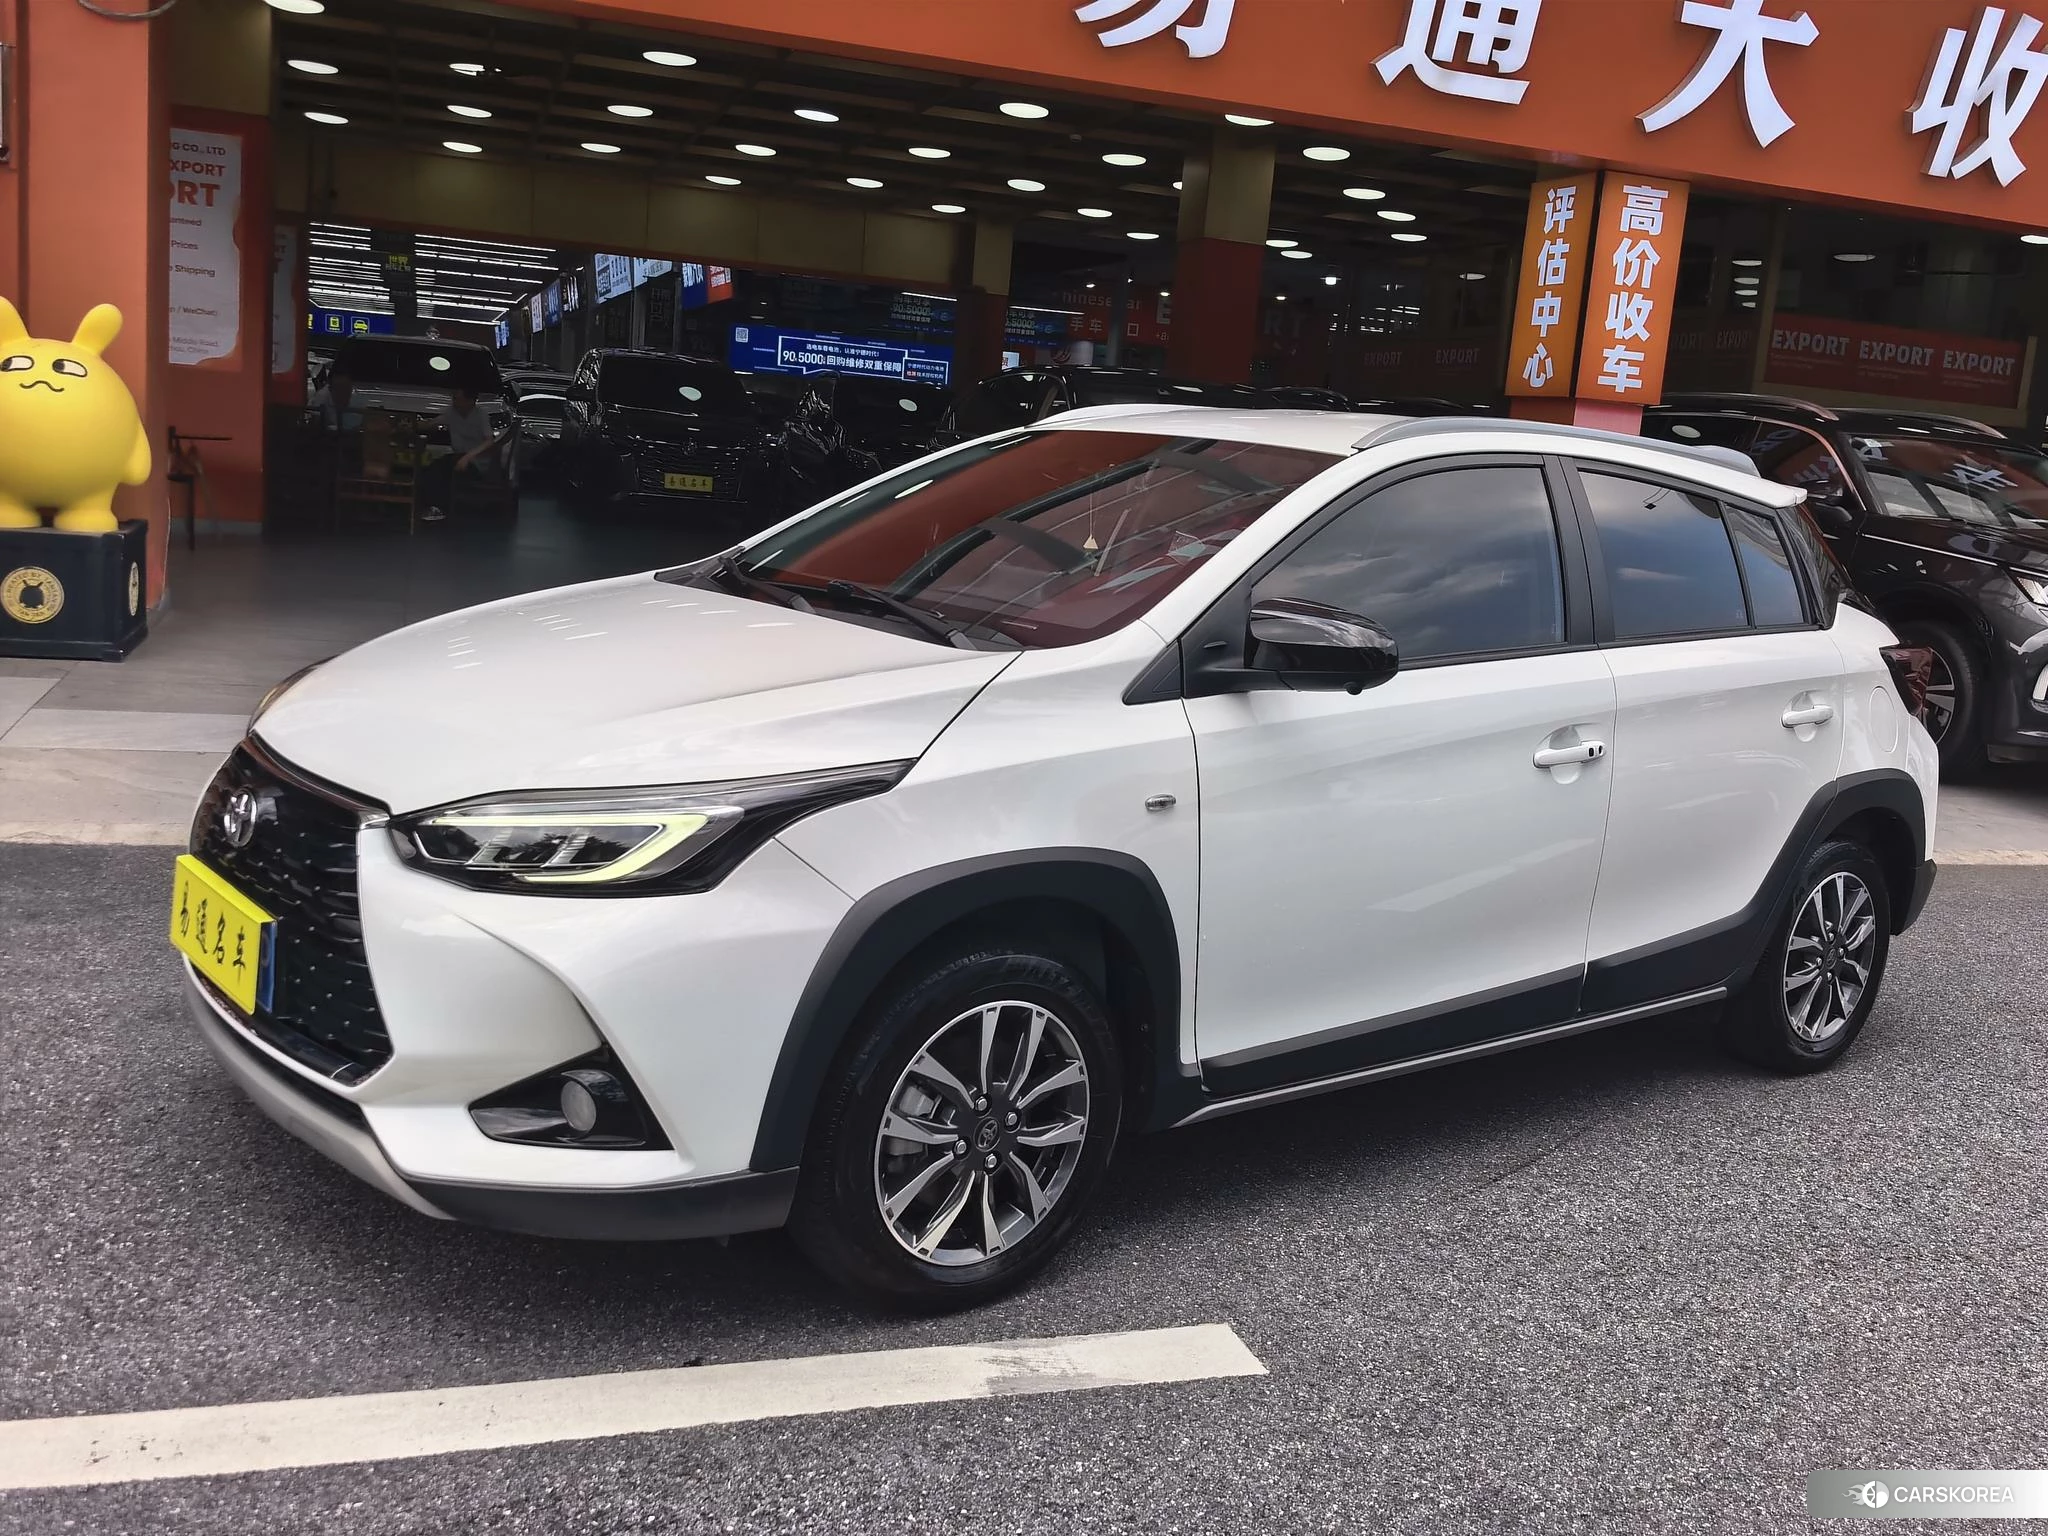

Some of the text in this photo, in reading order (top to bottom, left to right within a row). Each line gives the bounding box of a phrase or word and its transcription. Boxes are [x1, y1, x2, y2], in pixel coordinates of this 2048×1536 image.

[169, 159, 226, 177] XPORT
[169, 217, 202, 227] anteed
[171, 239, 198, 251] Prices
[175, 264, 216, 278] Shipping
[1522, 185, 1577, 389] 评估中心
[1597, 185, 1669, 393] 高价收车
[1062, 290, 1112, 307] hinese
[1771, 328, 1850, 357] EXPORT
[1436, 348, 1480, 365] EXPORT
[1859, 339, 1934, 367] EXPORT
[1942, 350, 2016, 377] EXPORT
